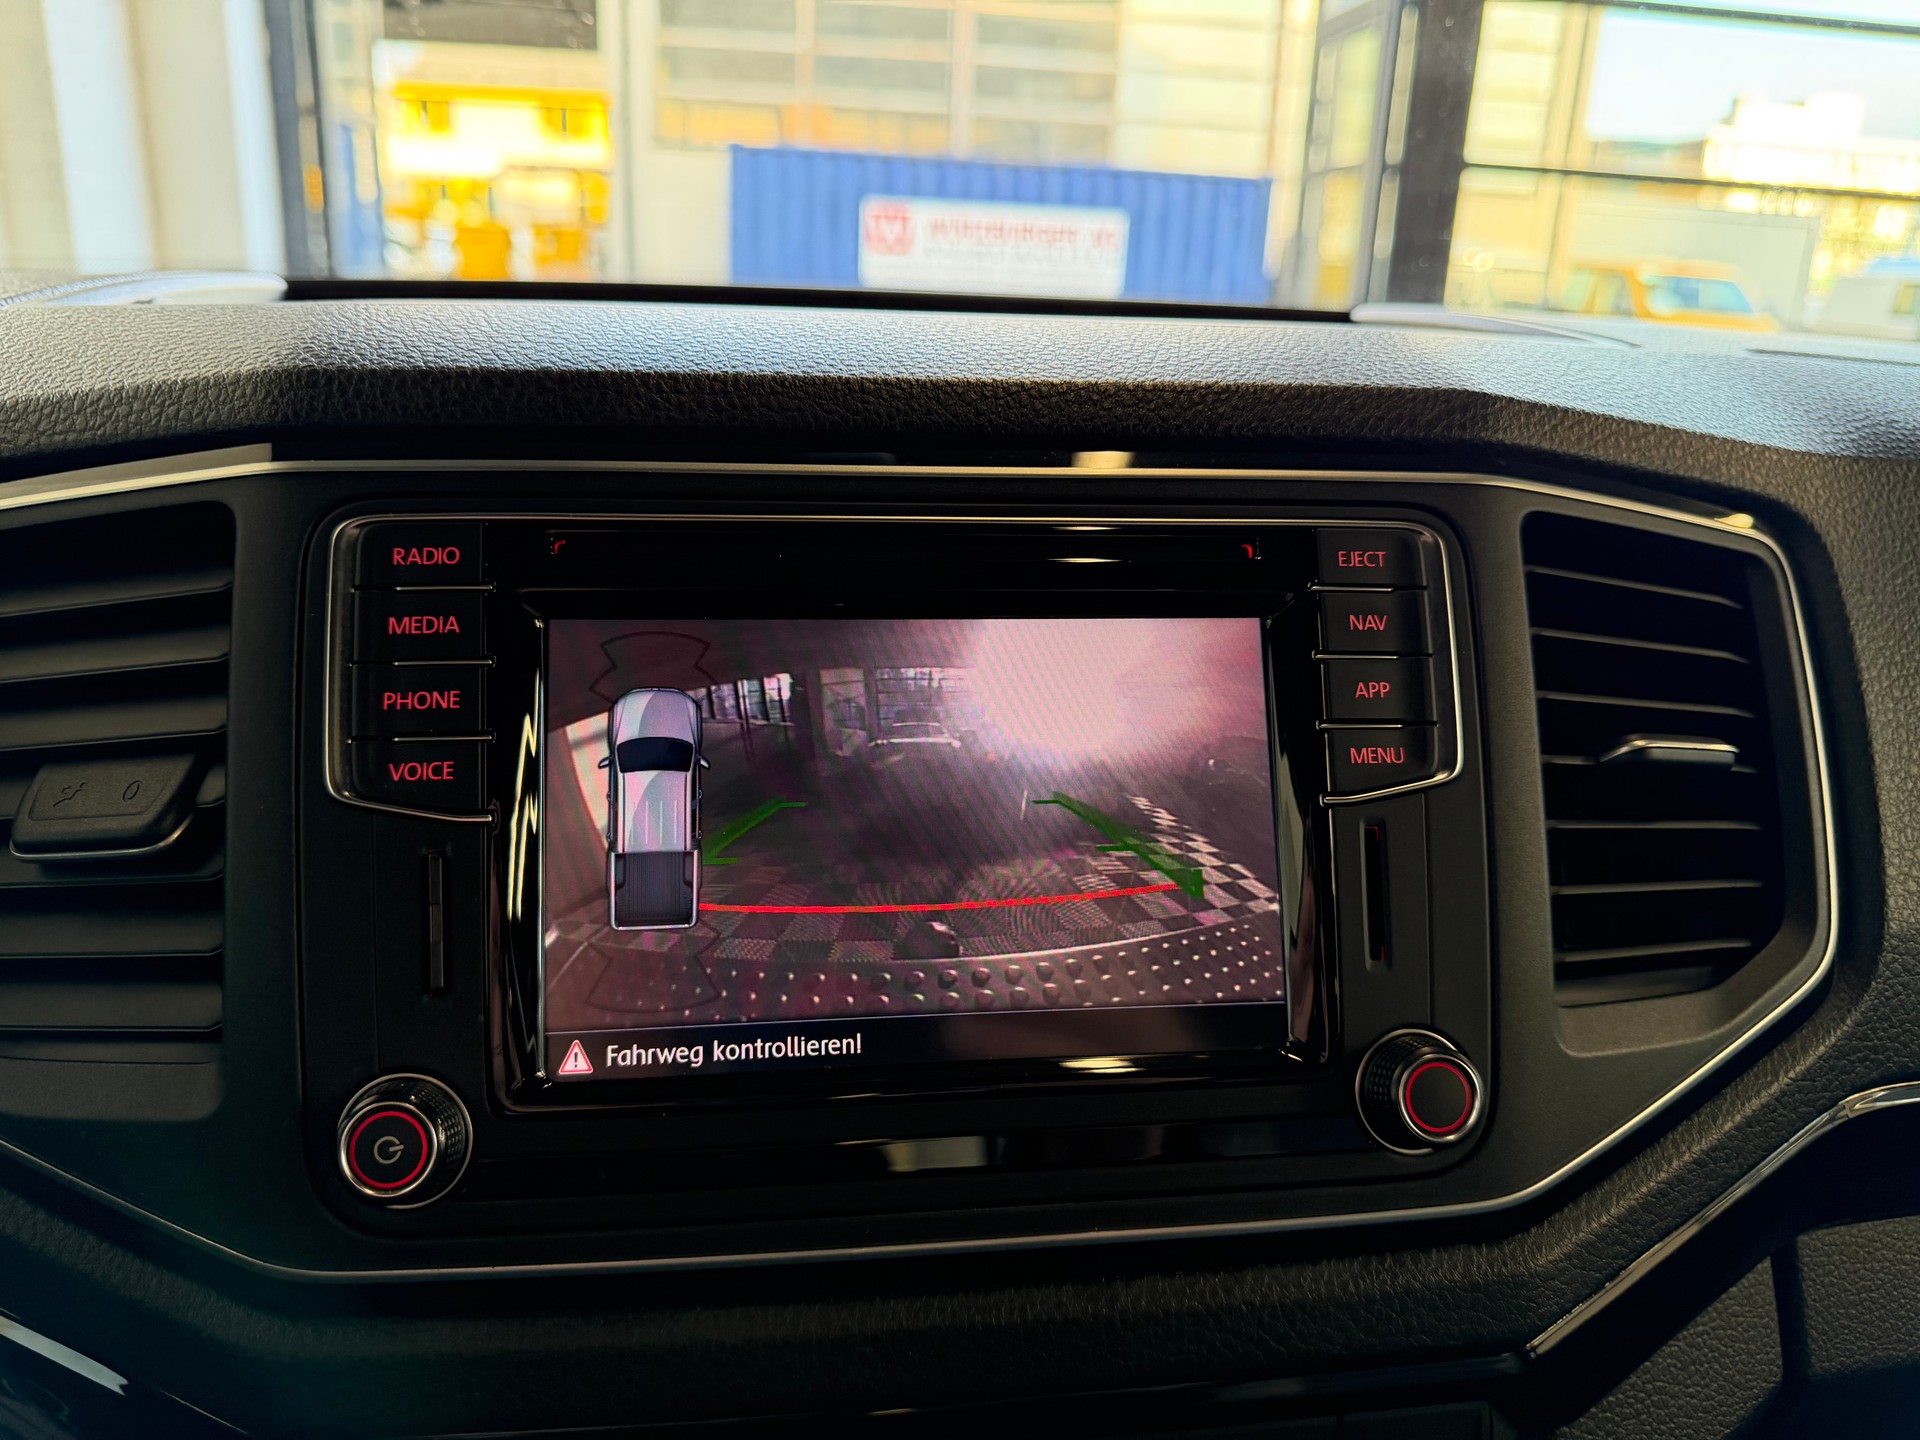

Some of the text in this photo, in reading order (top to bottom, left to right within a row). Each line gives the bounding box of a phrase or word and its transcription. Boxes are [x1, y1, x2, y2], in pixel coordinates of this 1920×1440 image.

[392, 547, 460, 566] RADIO
[1337, 551, 1387, 567] EJECT
[388, 615, 461, 634] MEDIA
[1349, 614, 1388, 631] NAV
[1355, 681, 1391, 698] APP
[382, 690, 461, 710] PHONE
[1350, 747, 1405, 764] MENU
[388, 761, 454, 781] VOICE
[605, 1033, 862, 1068] Fahrweg kontrollieren!
